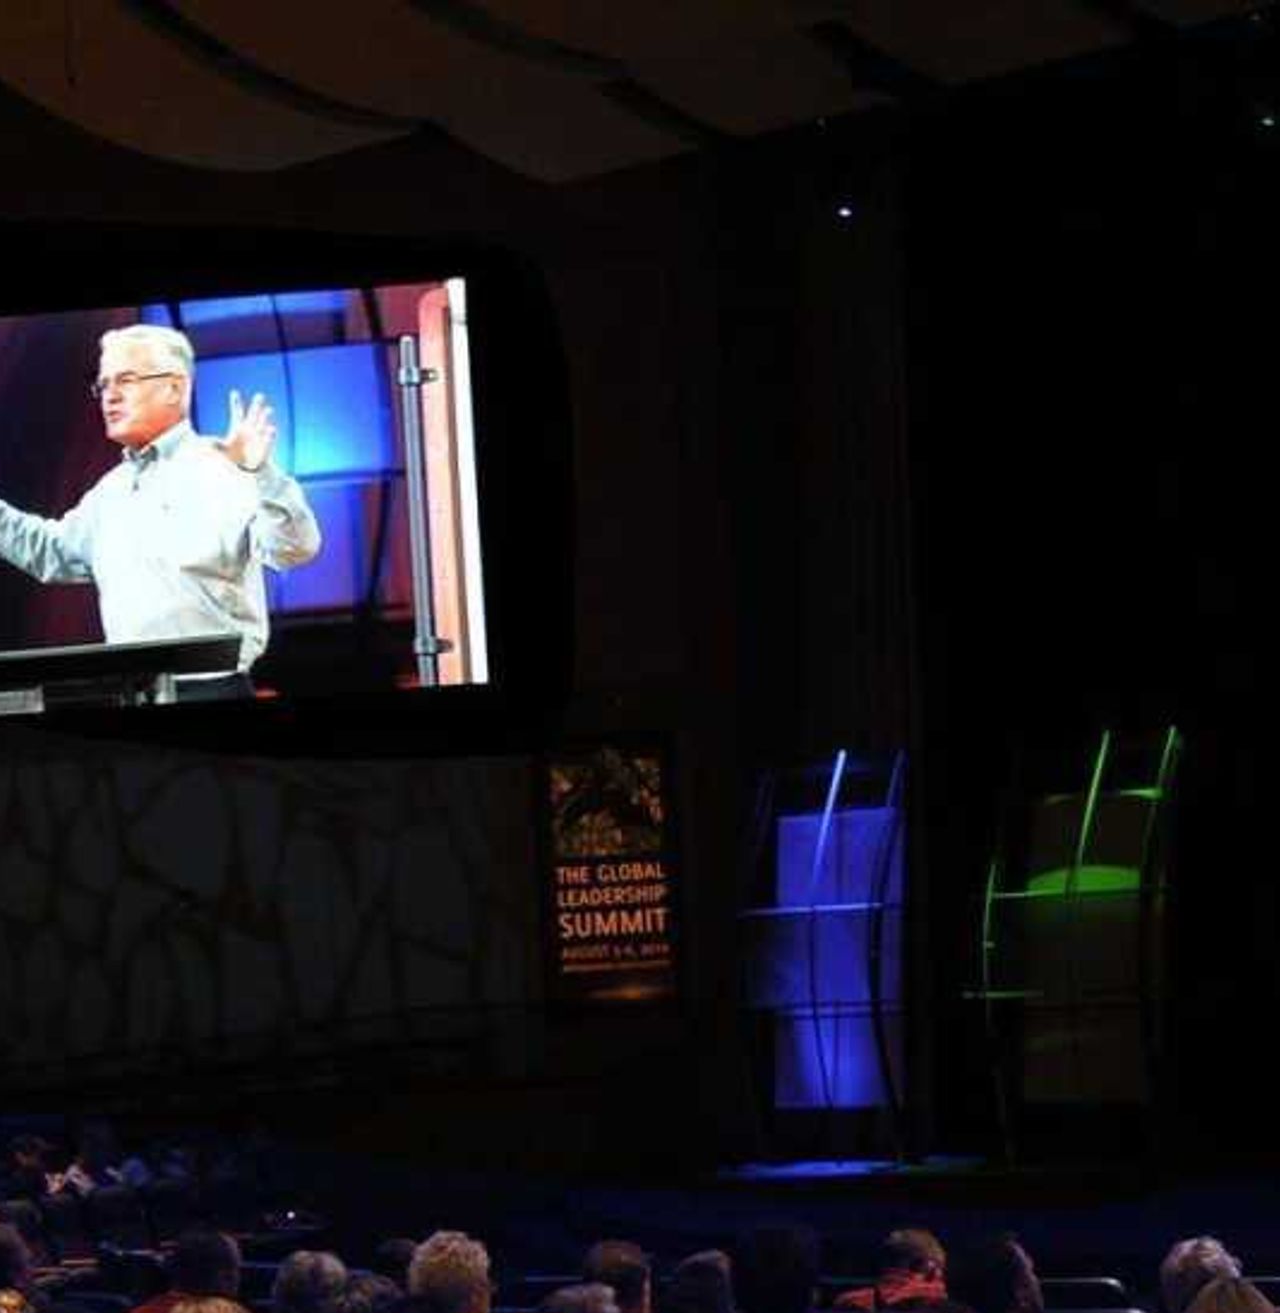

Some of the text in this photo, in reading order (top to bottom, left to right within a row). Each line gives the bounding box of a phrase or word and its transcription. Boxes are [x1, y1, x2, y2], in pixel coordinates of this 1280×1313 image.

[556, 862, 666, 884] THE GLOBAL
[557, 883, 667, 907] LEADERSHIP
[558, 907, 670, 938] SUMMIT
